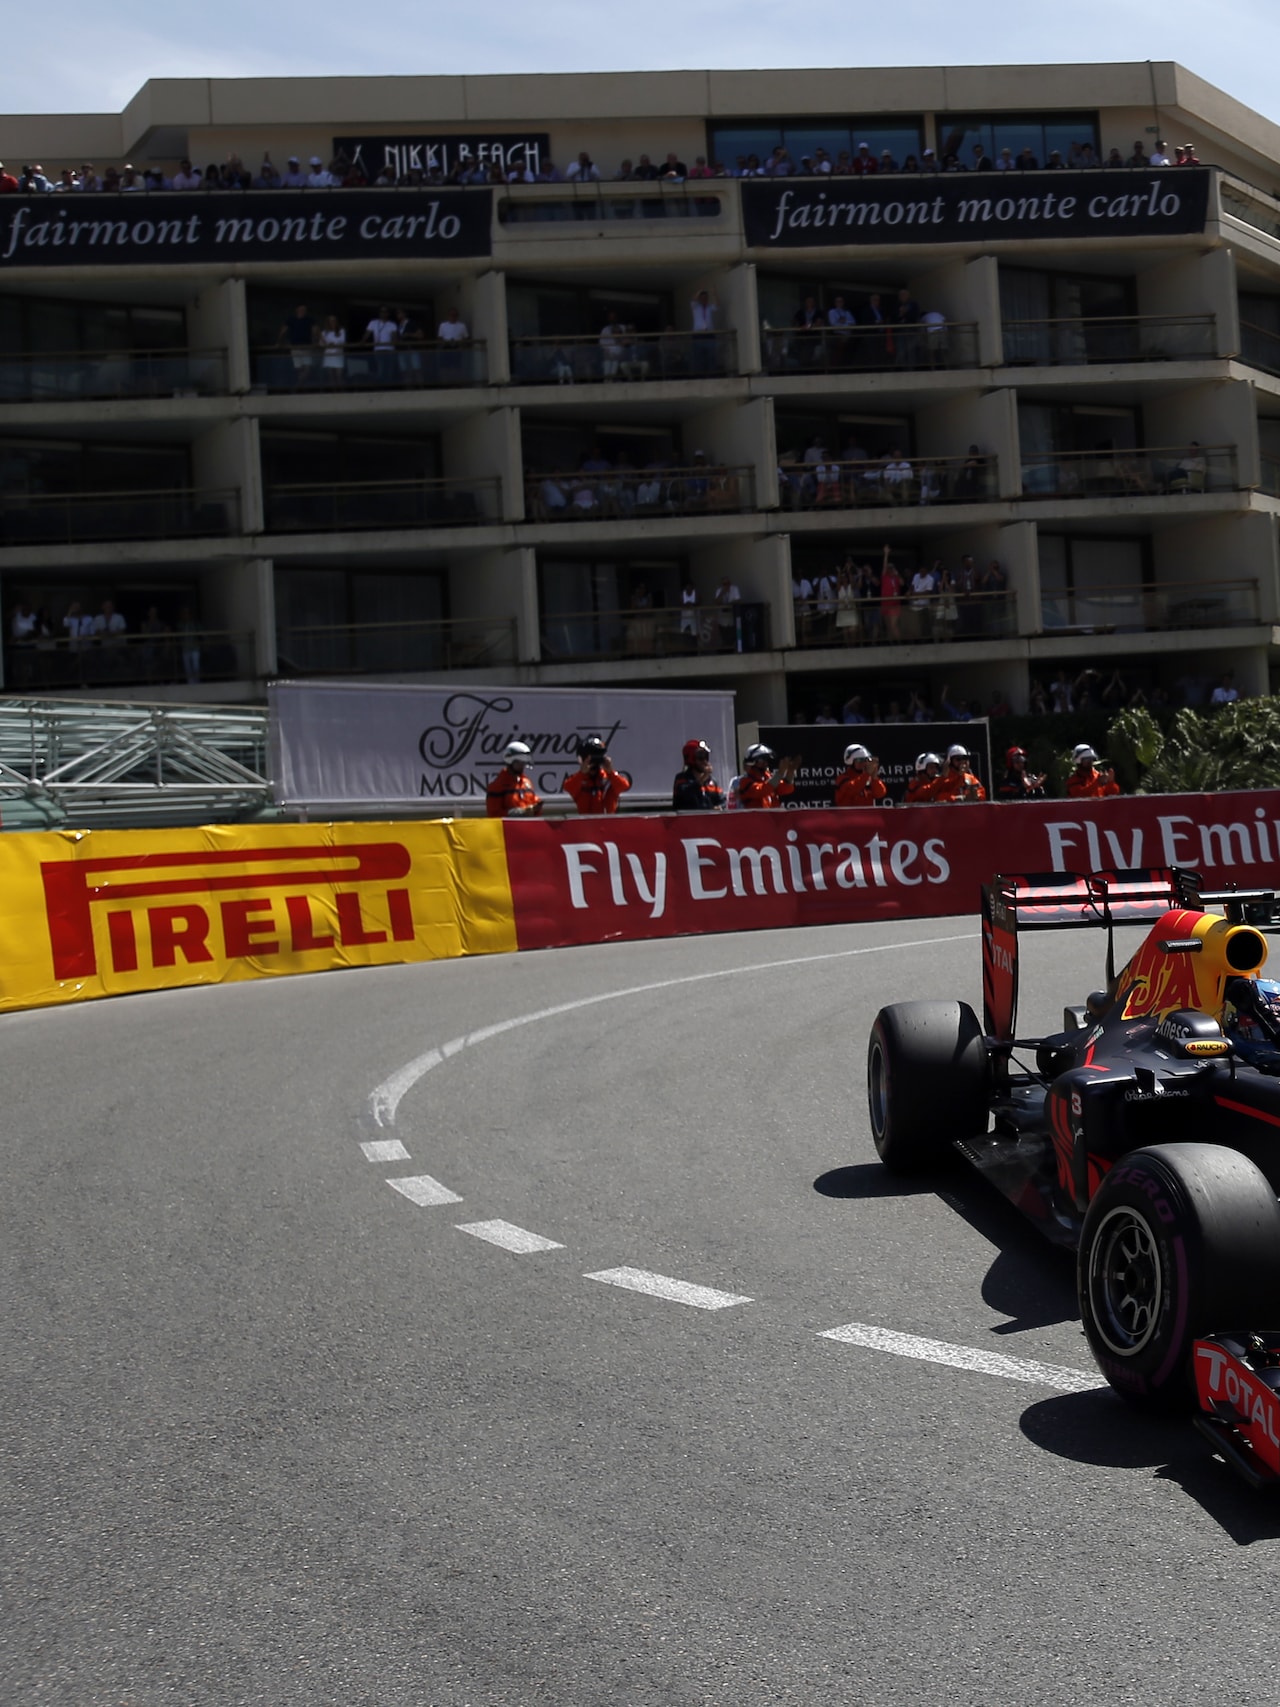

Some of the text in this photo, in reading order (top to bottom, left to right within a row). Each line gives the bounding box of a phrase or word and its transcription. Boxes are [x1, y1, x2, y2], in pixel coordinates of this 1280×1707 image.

[384, 142, 542, 179] NIKKI BEACH
[2, 202, 461, 259] fairmont monte carlo
[770, 181, 1182, 240] fairmont monte carlo
[561, 829, 951, 918] Fly Emirates
[1044, 820, 1143, 872] Fly
[40, 842, 415, 981] PIRELLI
[1196, 1044, 1222, 1052] RAUCH
[1070, 1091, 1083, 1116] 3
[1111, 1167, 1176, 1224] ZERO
